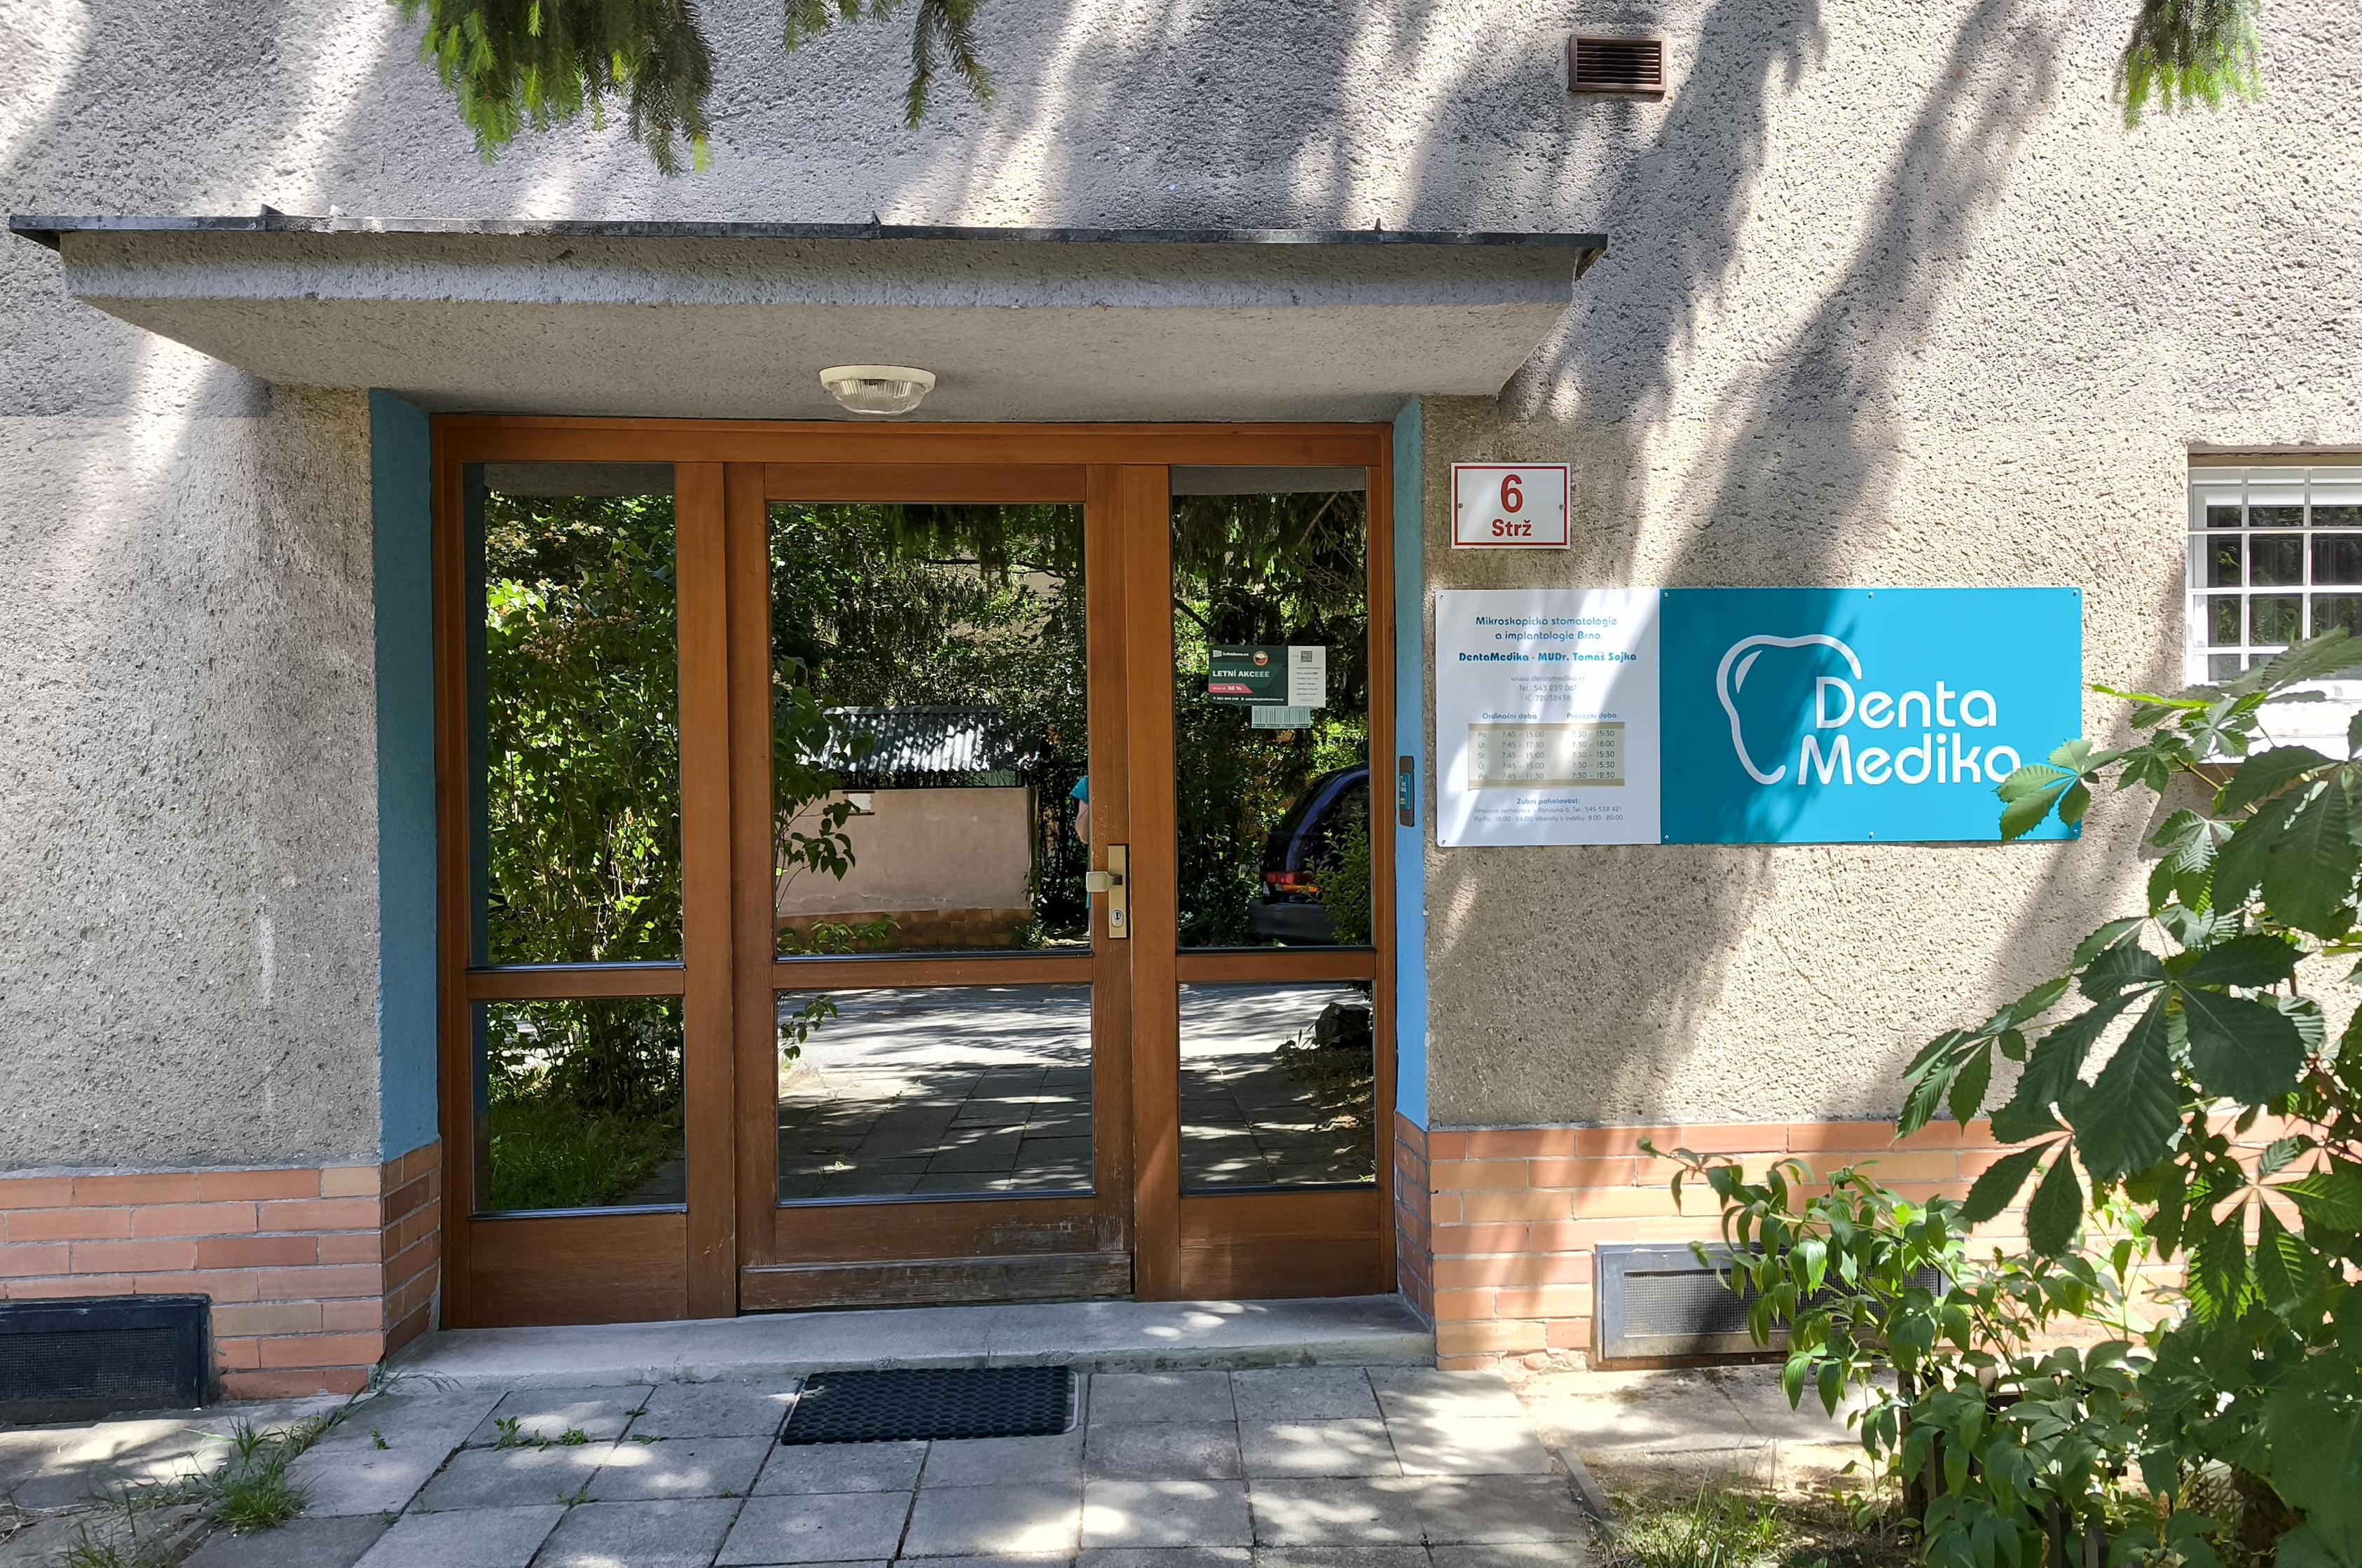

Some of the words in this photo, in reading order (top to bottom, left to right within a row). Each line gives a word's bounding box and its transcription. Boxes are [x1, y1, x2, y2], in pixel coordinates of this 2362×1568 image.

[1501, 474, 1523, 513] 6
[1492, 519, 1532, 537] Strž
[1476, 616, 1548, 627] Mikroskopická
[1551, 617, 1617, 627] stomatologie
[1504, 631, 1574, 642] implantologie
[1577, 631, 1600, 640] Brno
[1459, 652, 1529, 661] DentaMedika
[1538, 652, 1570, 661] MUDr.
[1572, 652, 1605, 661] Tomáš
[1608, 652, 1637, 663] Sojka
[1212, 668, 1236, 678] LETNÍ
[1816, 676, 1997, 729] Denta
[1798, 732, 2021, 785] Medika
